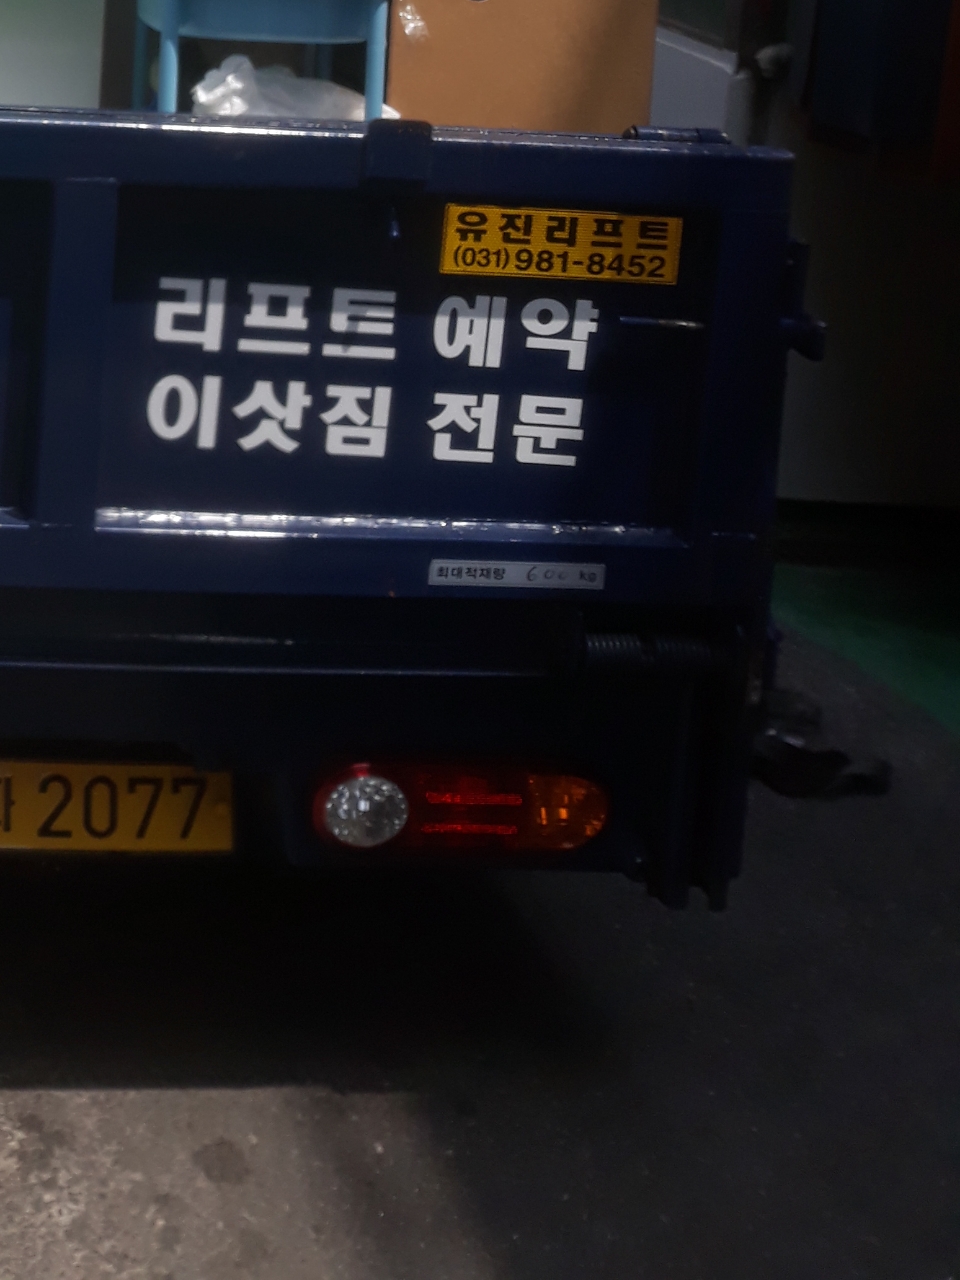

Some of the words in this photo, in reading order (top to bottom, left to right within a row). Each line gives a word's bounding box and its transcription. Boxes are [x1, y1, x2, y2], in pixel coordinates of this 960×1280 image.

[454, 211, 671, 250] 유진리프트
[153, 276, 398, 360] 리프트
[433, 294, 600, 371] 예약
[146, 374, 393, 458] 이삿짐
[427, 392, 586, 467] 전문
[36, 774, 210, 840] 2077
